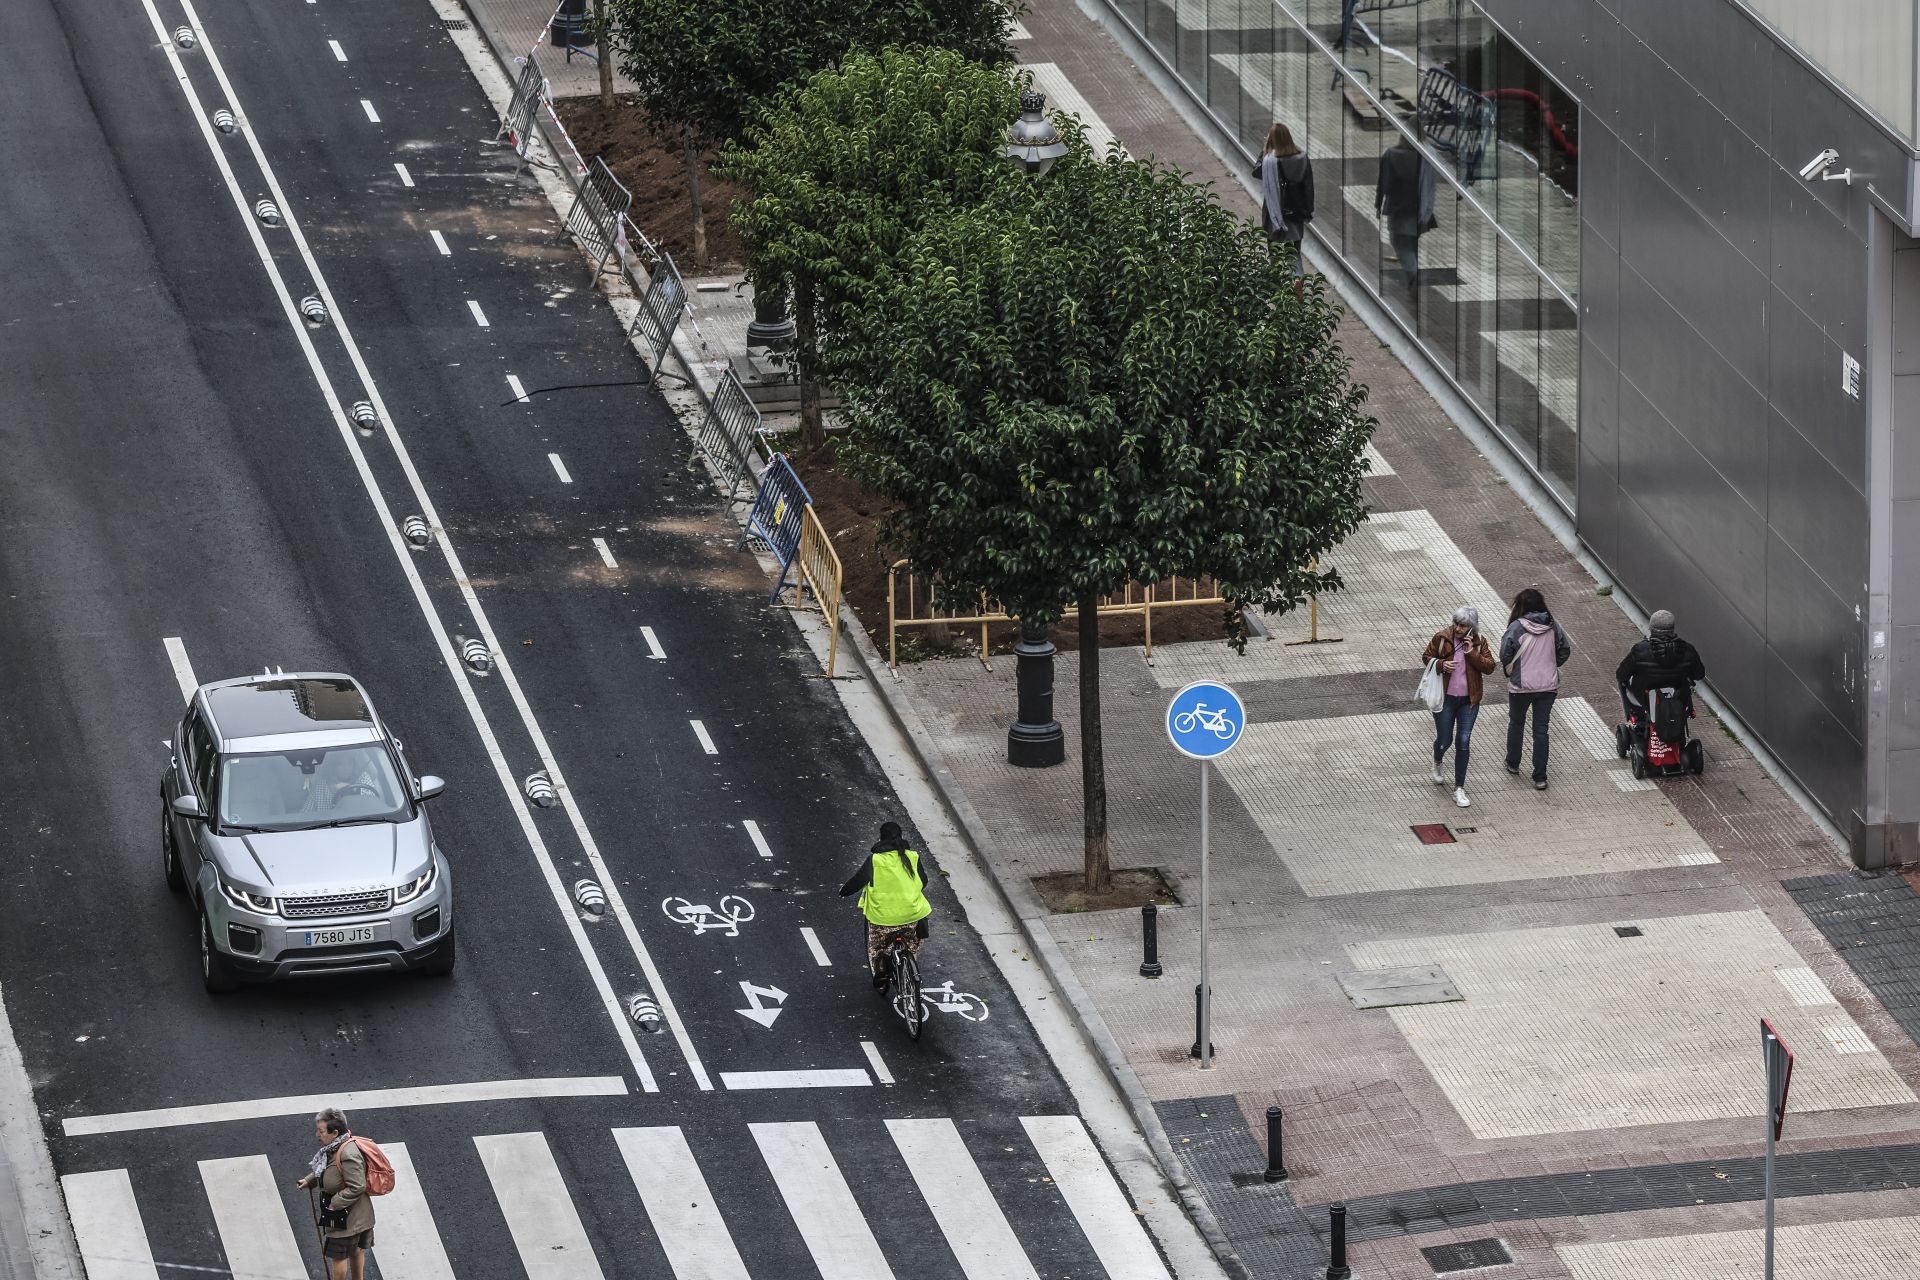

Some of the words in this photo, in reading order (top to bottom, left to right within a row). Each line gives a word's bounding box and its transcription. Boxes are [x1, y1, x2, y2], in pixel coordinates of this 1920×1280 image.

[280, 888, 329, 896] RANGE
[338, 882, 387, 893] ROVER
[313, 931, 345, 944] 7580
[349, 928, 372, 942] JTS
